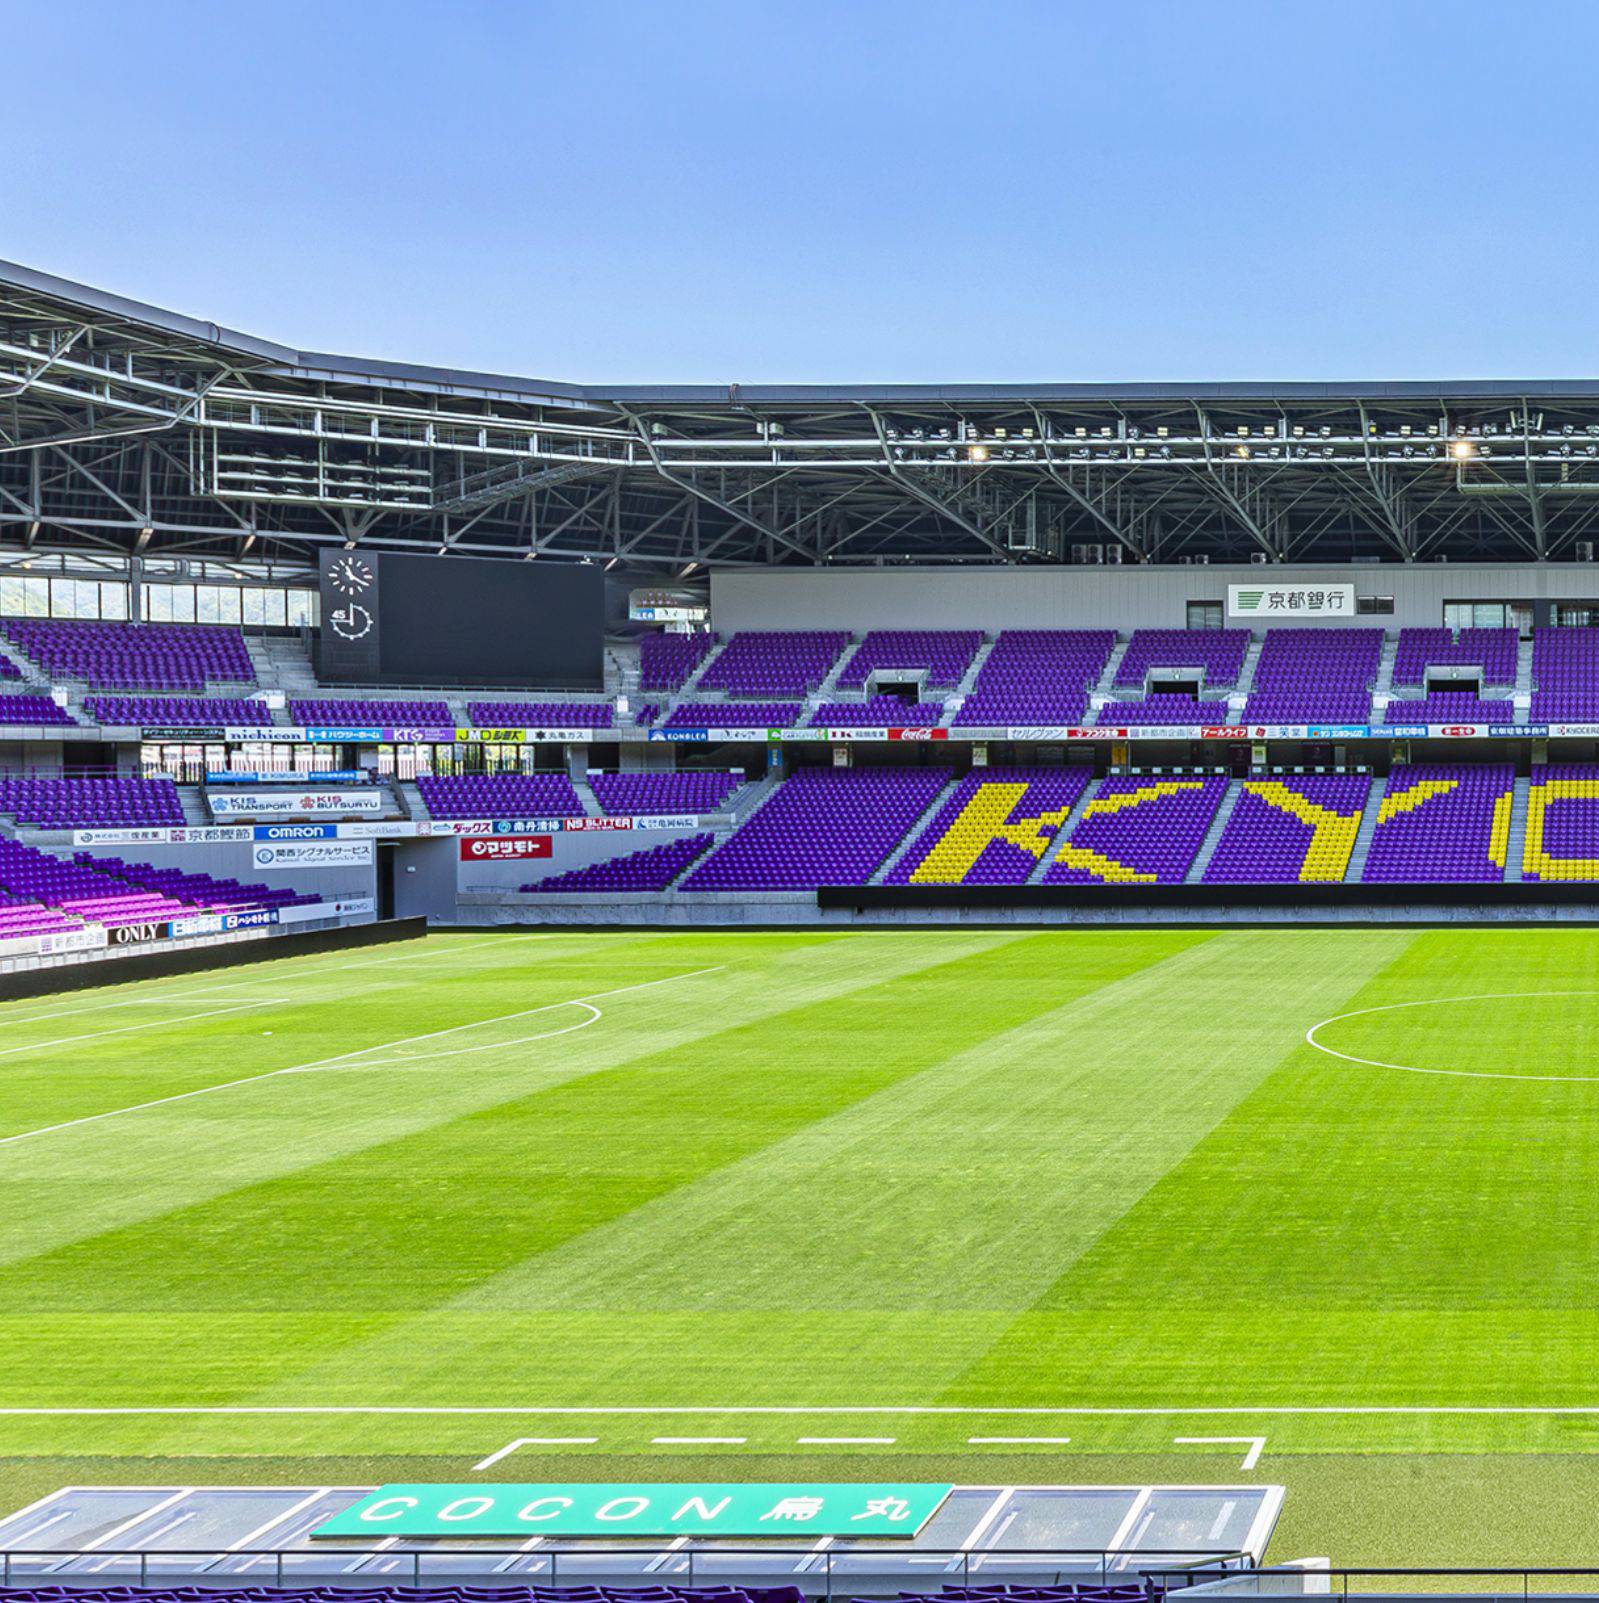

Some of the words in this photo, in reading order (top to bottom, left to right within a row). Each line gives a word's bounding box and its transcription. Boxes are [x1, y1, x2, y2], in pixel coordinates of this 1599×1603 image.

[1268, 591, 1345, 610] 京都銀行
[331, 609, 346, 619] 45
[230, 728, 301, 740] nichicon
[393, 729, 423, 741] KTG
[1566, 726, 1599, 735] KYOCERA
[231, 803, 293, 811] TRANSPORT
[316, 801, 378, 809] BUTSURYU
[452, 822, 492, 834] ダックス
[276, 846, 371, 858] 関西シグナルサービス
[485, 840, 541, 854] マツモト
[116, 922, 160, 944] ONLY
[358, 1495, 733, 1522] COCON
